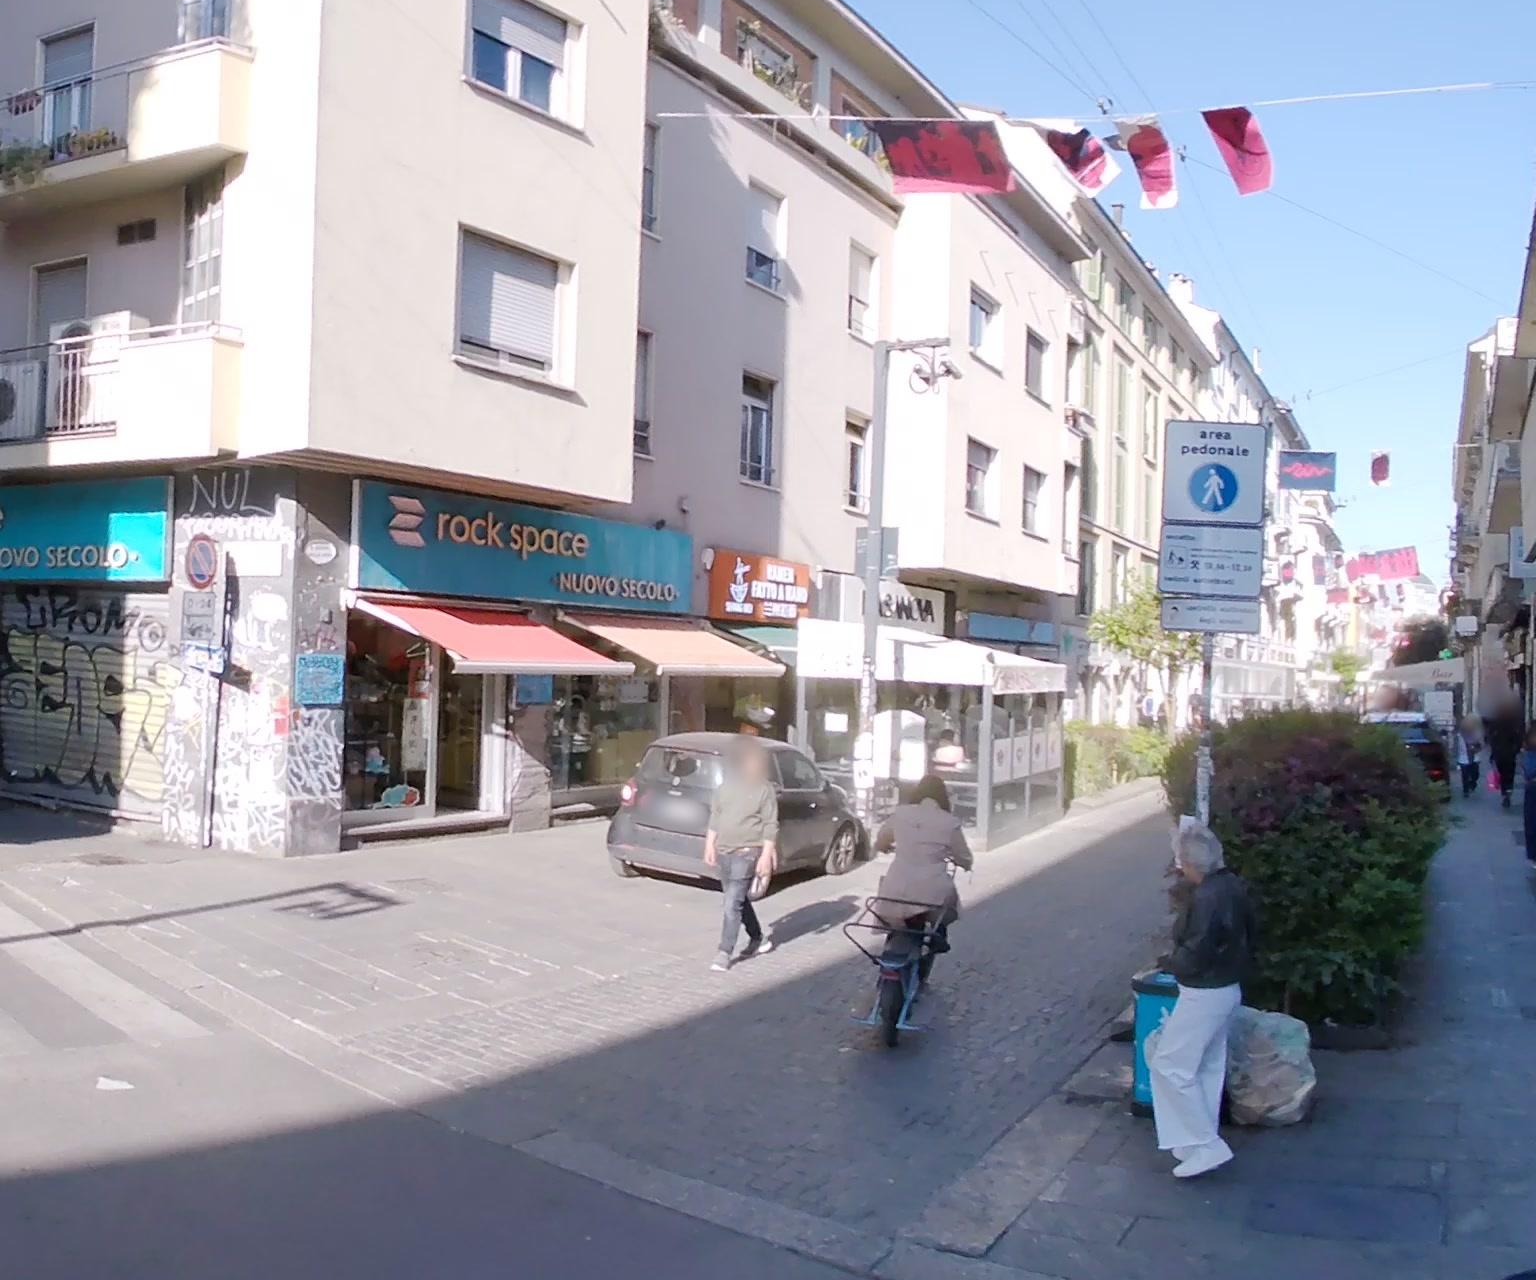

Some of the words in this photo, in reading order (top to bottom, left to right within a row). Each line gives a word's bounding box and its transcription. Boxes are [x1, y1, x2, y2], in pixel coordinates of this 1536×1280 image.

[1199, 430, 1232, 441] area
[1181, 443, 1250, 457] pedonale
[437, 511, 504, 549] rock
[510, 523, 591, 560] space
[46, 543, 129, 569] SECOLO
[558, 572, 618, 597] NUOVO
[621, 577, 675, 602] SECOLO
